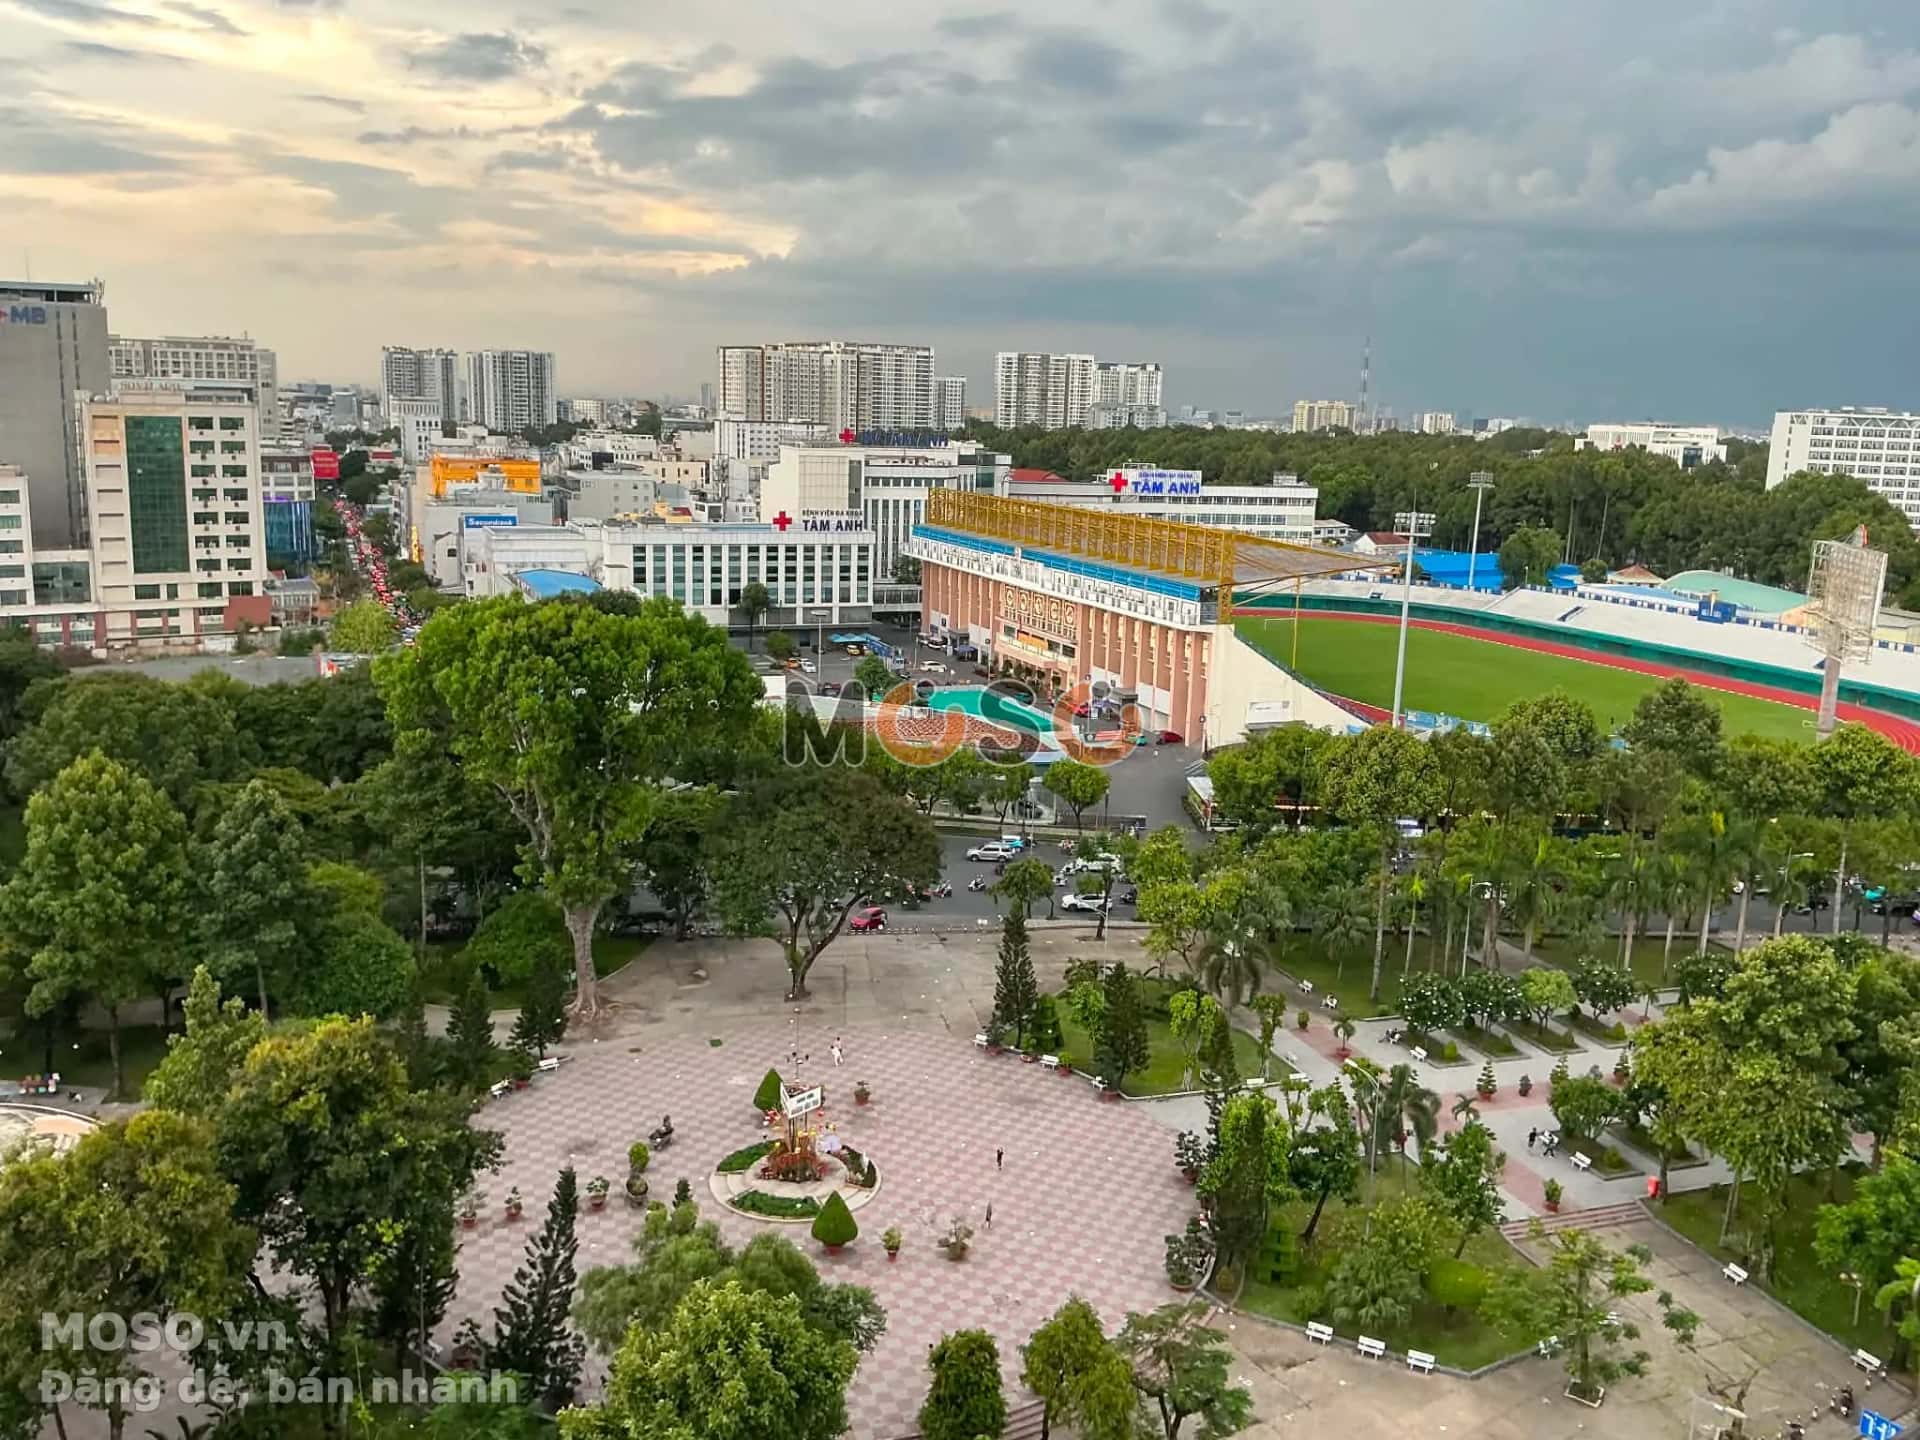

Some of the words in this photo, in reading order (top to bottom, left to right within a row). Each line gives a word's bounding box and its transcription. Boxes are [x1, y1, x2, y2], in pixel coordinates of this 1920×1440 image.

[10, 305, 47, 325] MB
[1132, 479, 1163, 493] TÂM
[1168, 481, 1200, 494] ANH
[802, 516, 830, 531] TÂM
[835, 519, 863, 531] ANH
